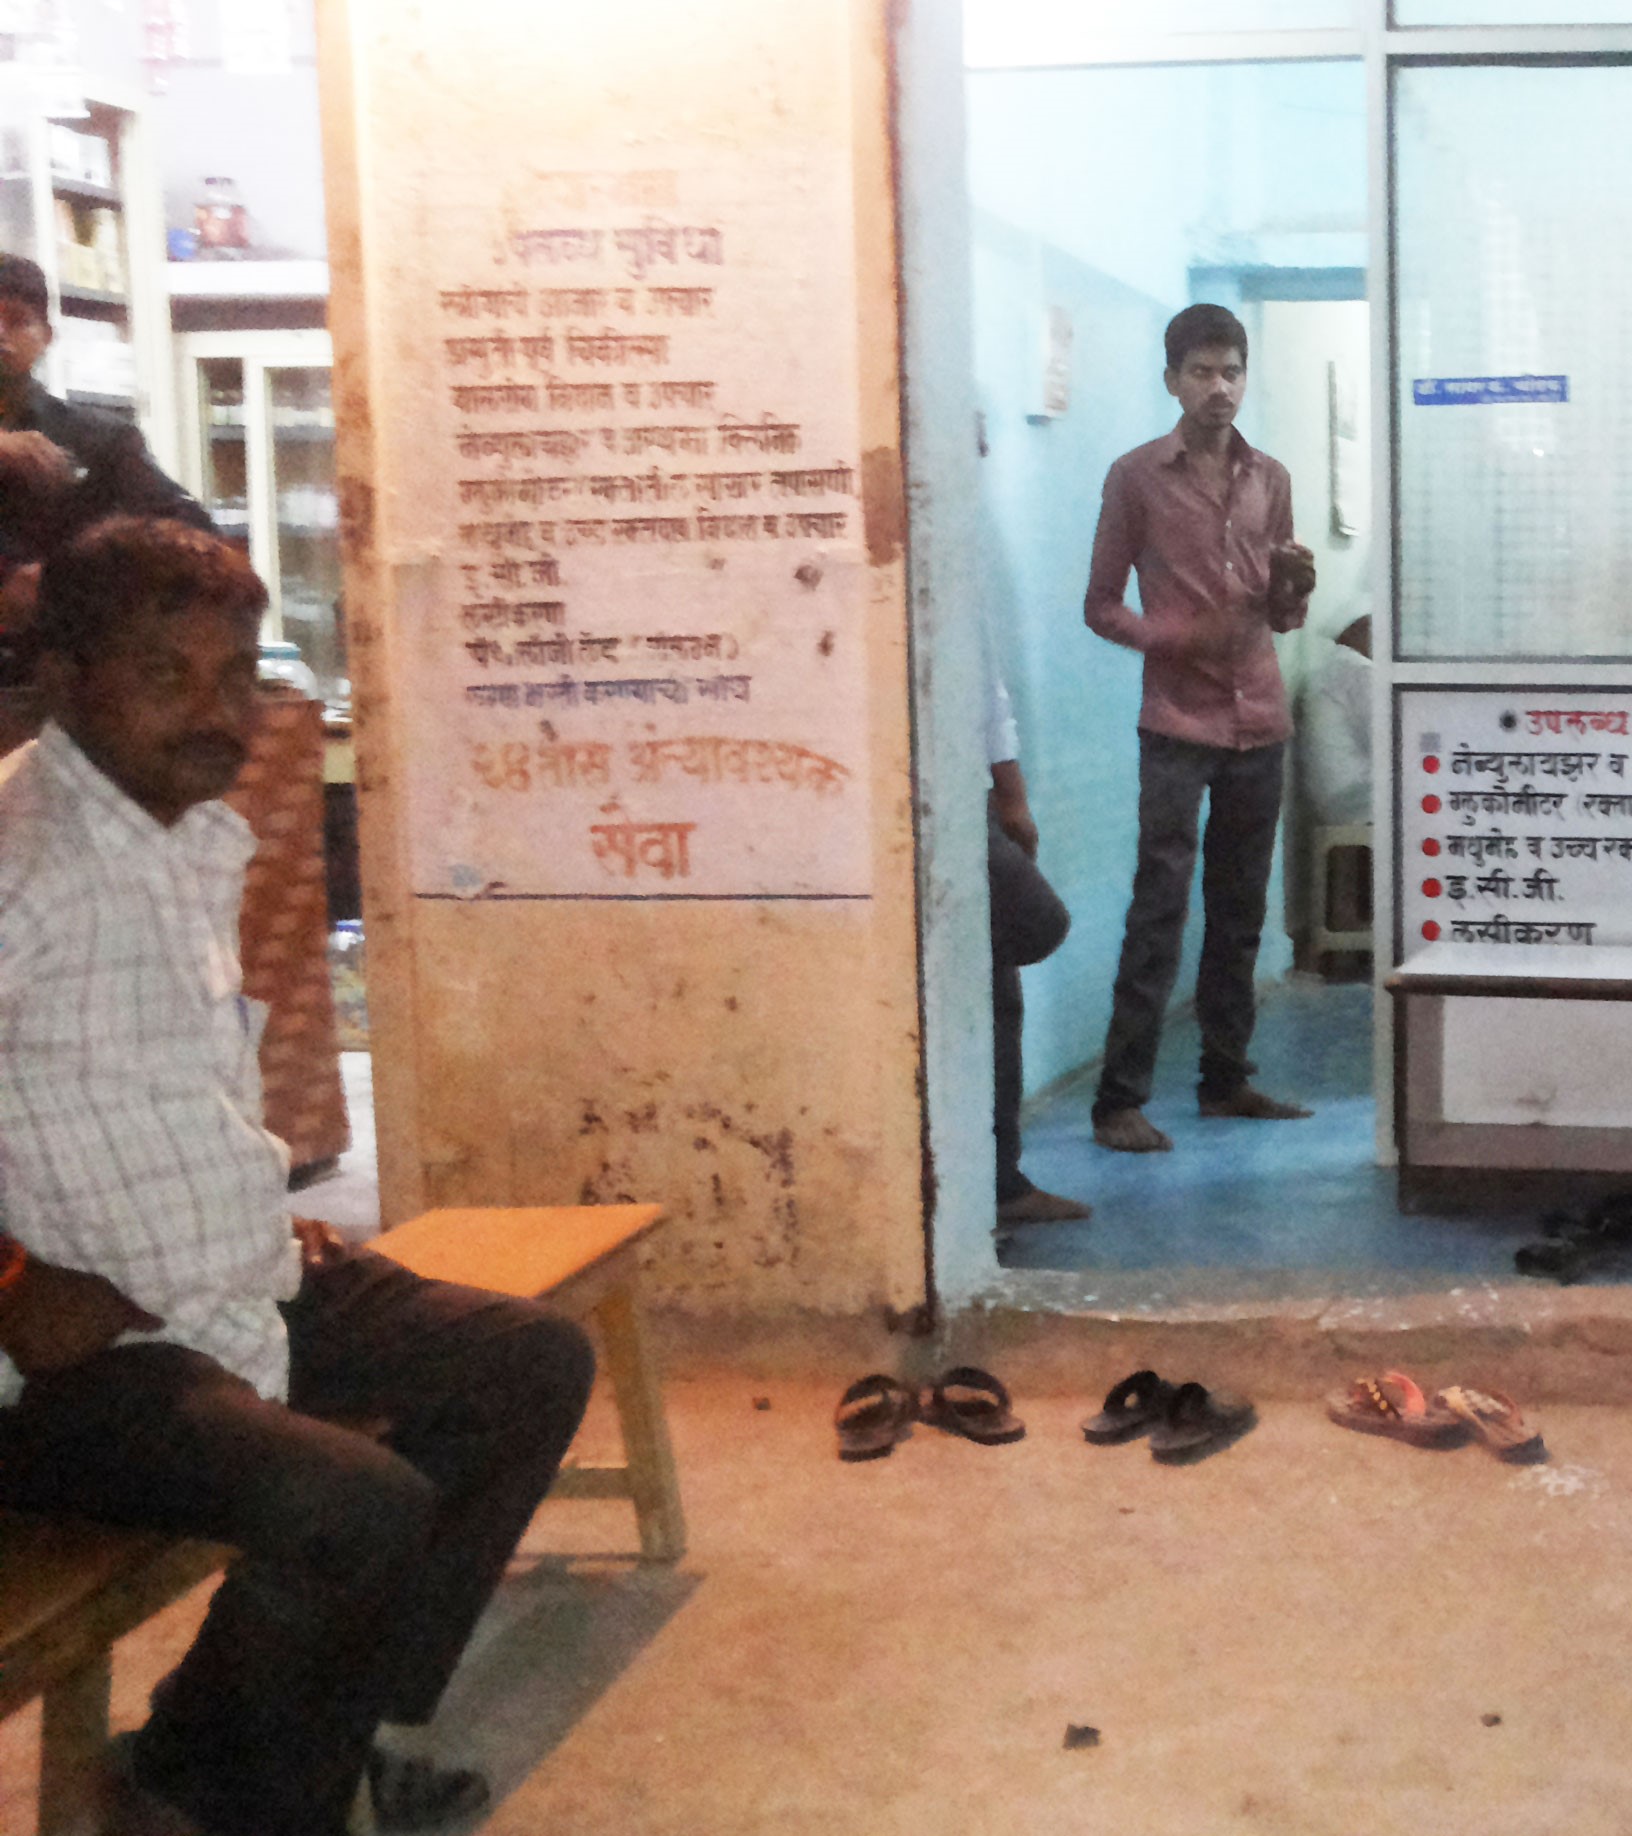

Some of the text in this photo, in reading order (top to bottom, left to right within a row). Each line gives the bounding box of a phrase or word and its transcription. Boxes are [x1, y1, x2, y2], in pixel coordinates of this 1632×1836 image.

[1526, 710, 1629, 737] उपलब्ध
[1609, 752, 1630, 778] व
[1525, 836, 1547, 861] व
[1450, 913, 1598, 946] लसीकरण
